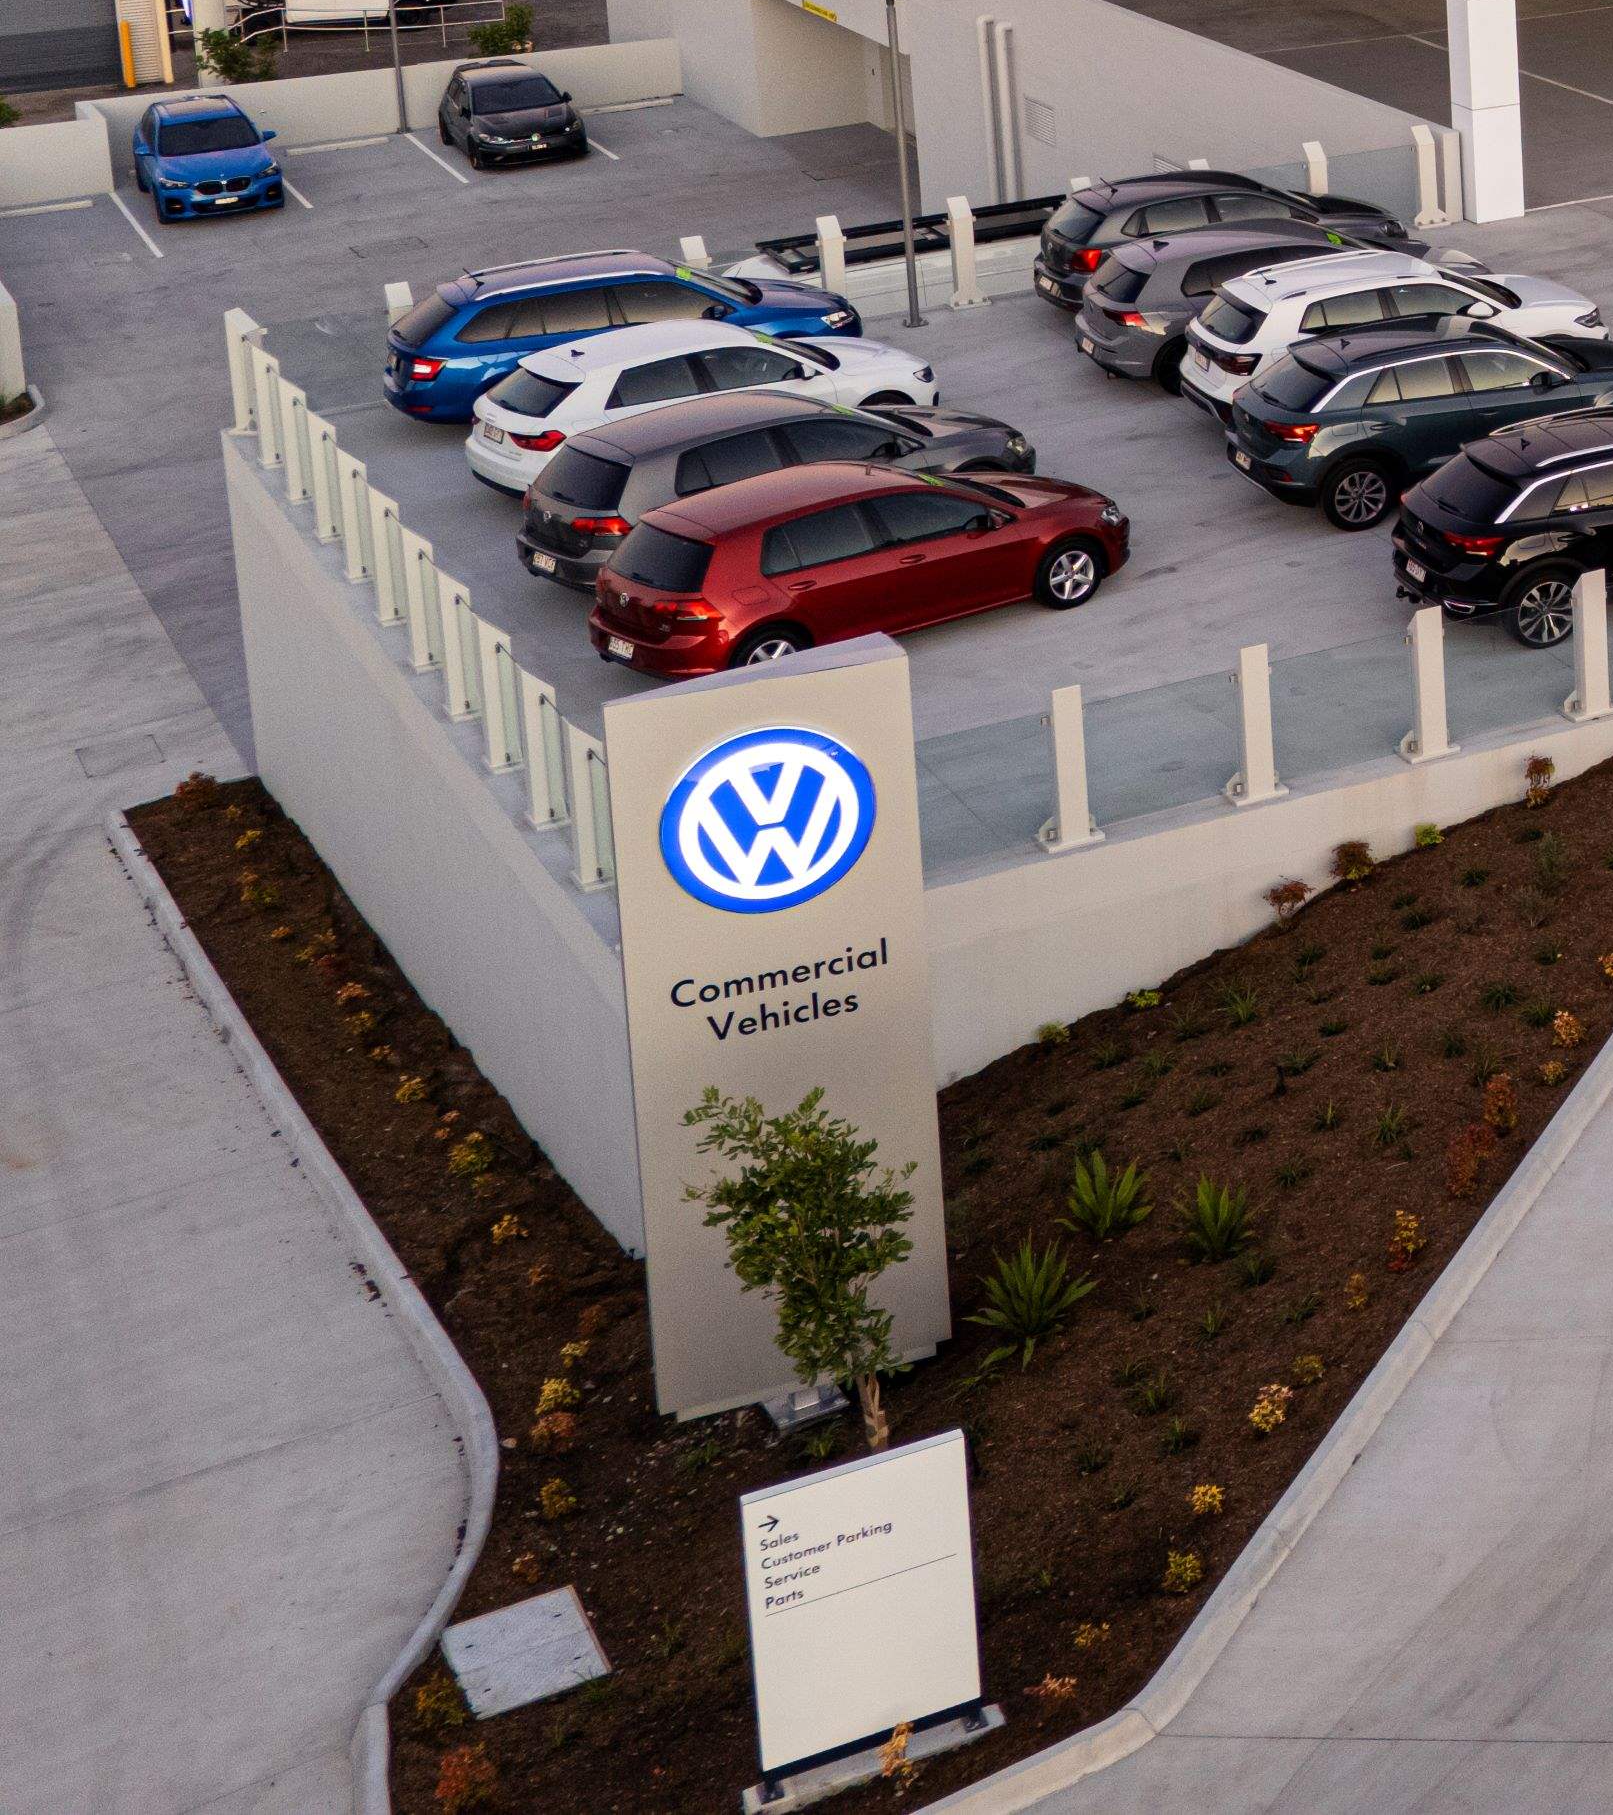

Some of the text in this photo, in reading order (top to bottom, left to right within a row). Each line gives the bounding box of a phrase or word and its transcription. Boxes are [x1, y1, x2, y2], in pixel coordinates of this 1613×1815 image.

[670, 937, 888, 1008] Commercial
[706, 991, 860, 1042] Vehicles
[760, 1532, 800, 1552] Sales
[761, 1521, 893, 1570] Customer Parking
[764, 1564, 821, 1590] Service
[765, 1590, 804, 1610] Parts
